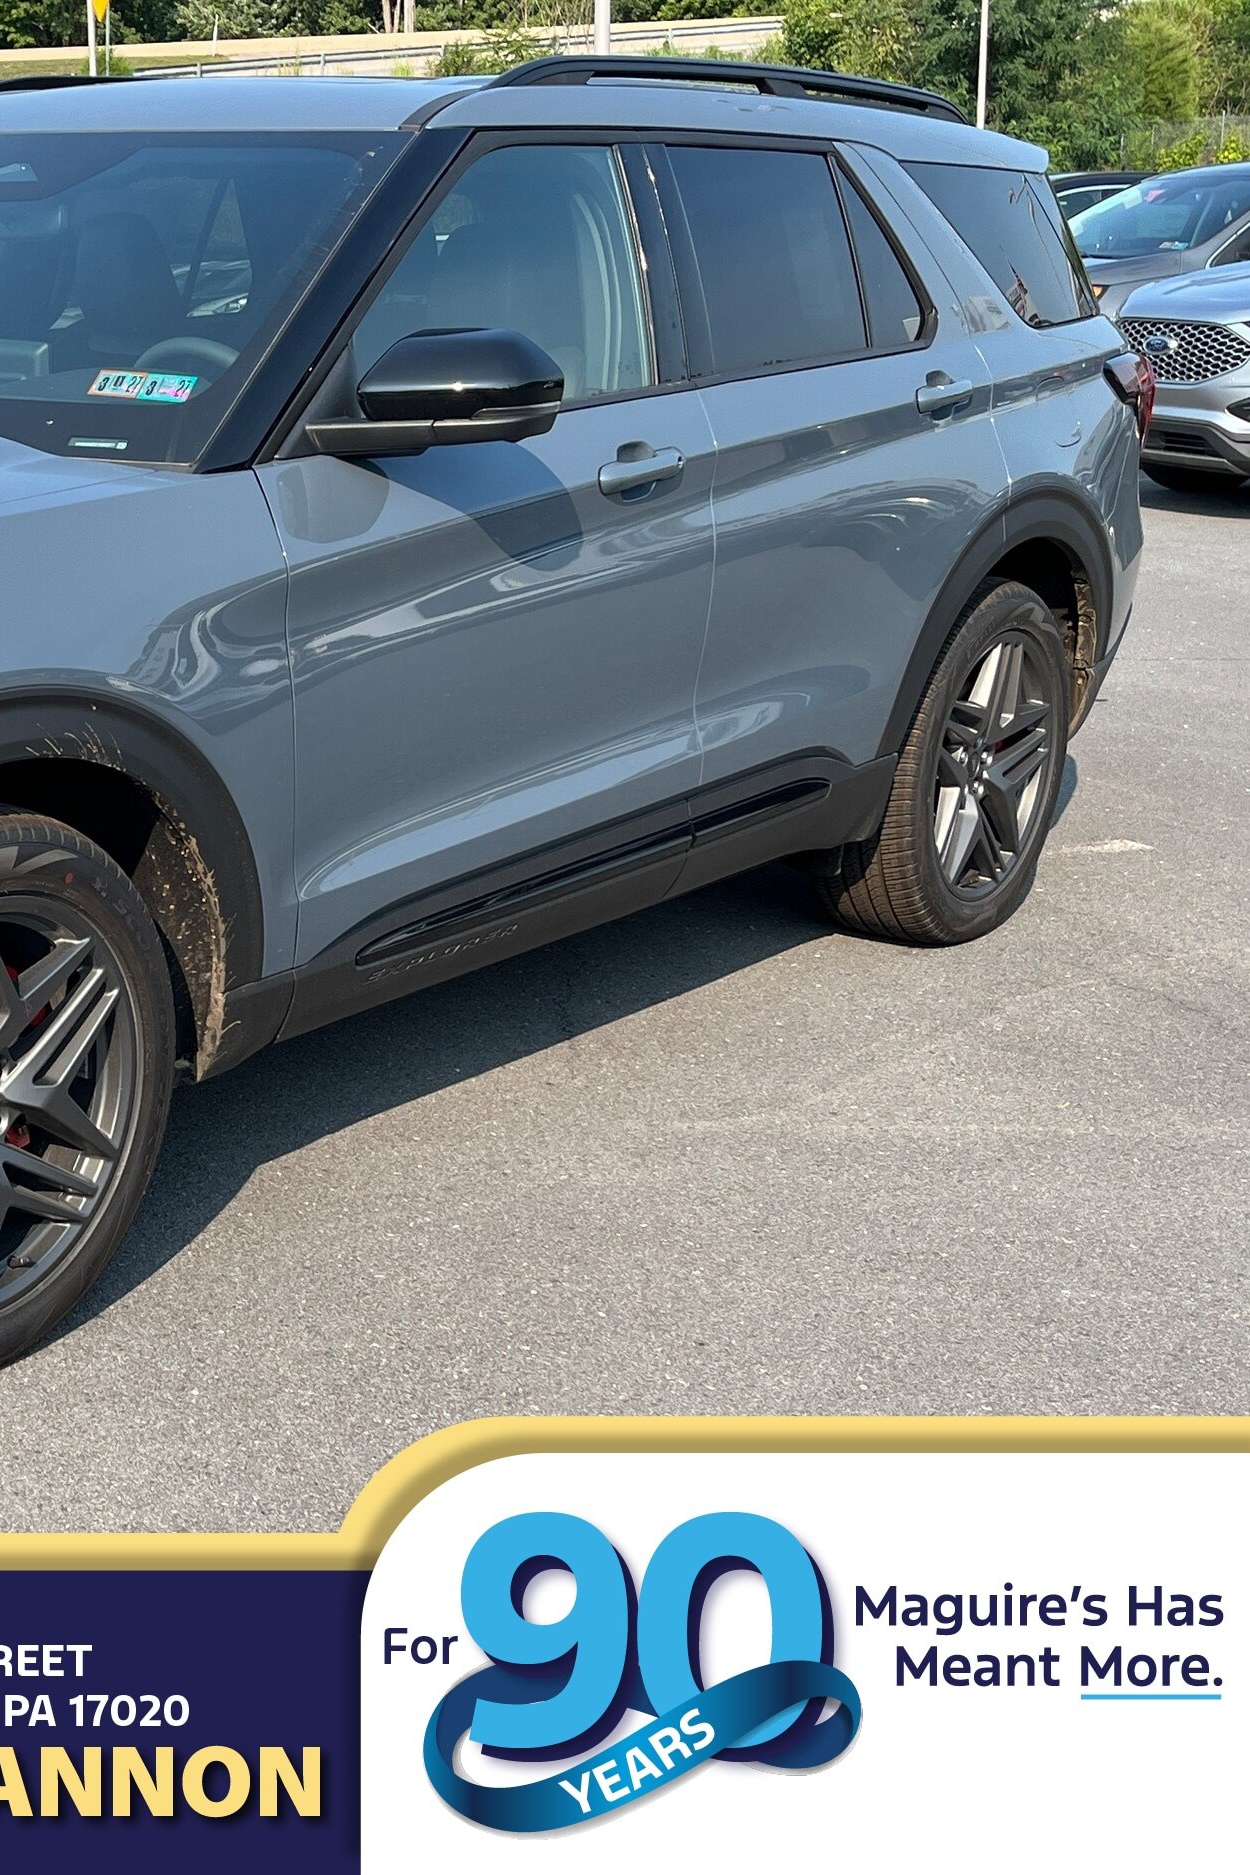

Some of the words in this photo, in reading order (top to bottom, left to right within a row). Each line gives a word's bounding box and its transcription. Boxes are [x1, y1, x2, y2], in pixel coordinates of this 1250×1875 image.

[97, 376, 111, 392] 3
[125, 375, 143, 394] 27
[145, 380, 158, 396] 3
[173, 379, 193, 398] 27
